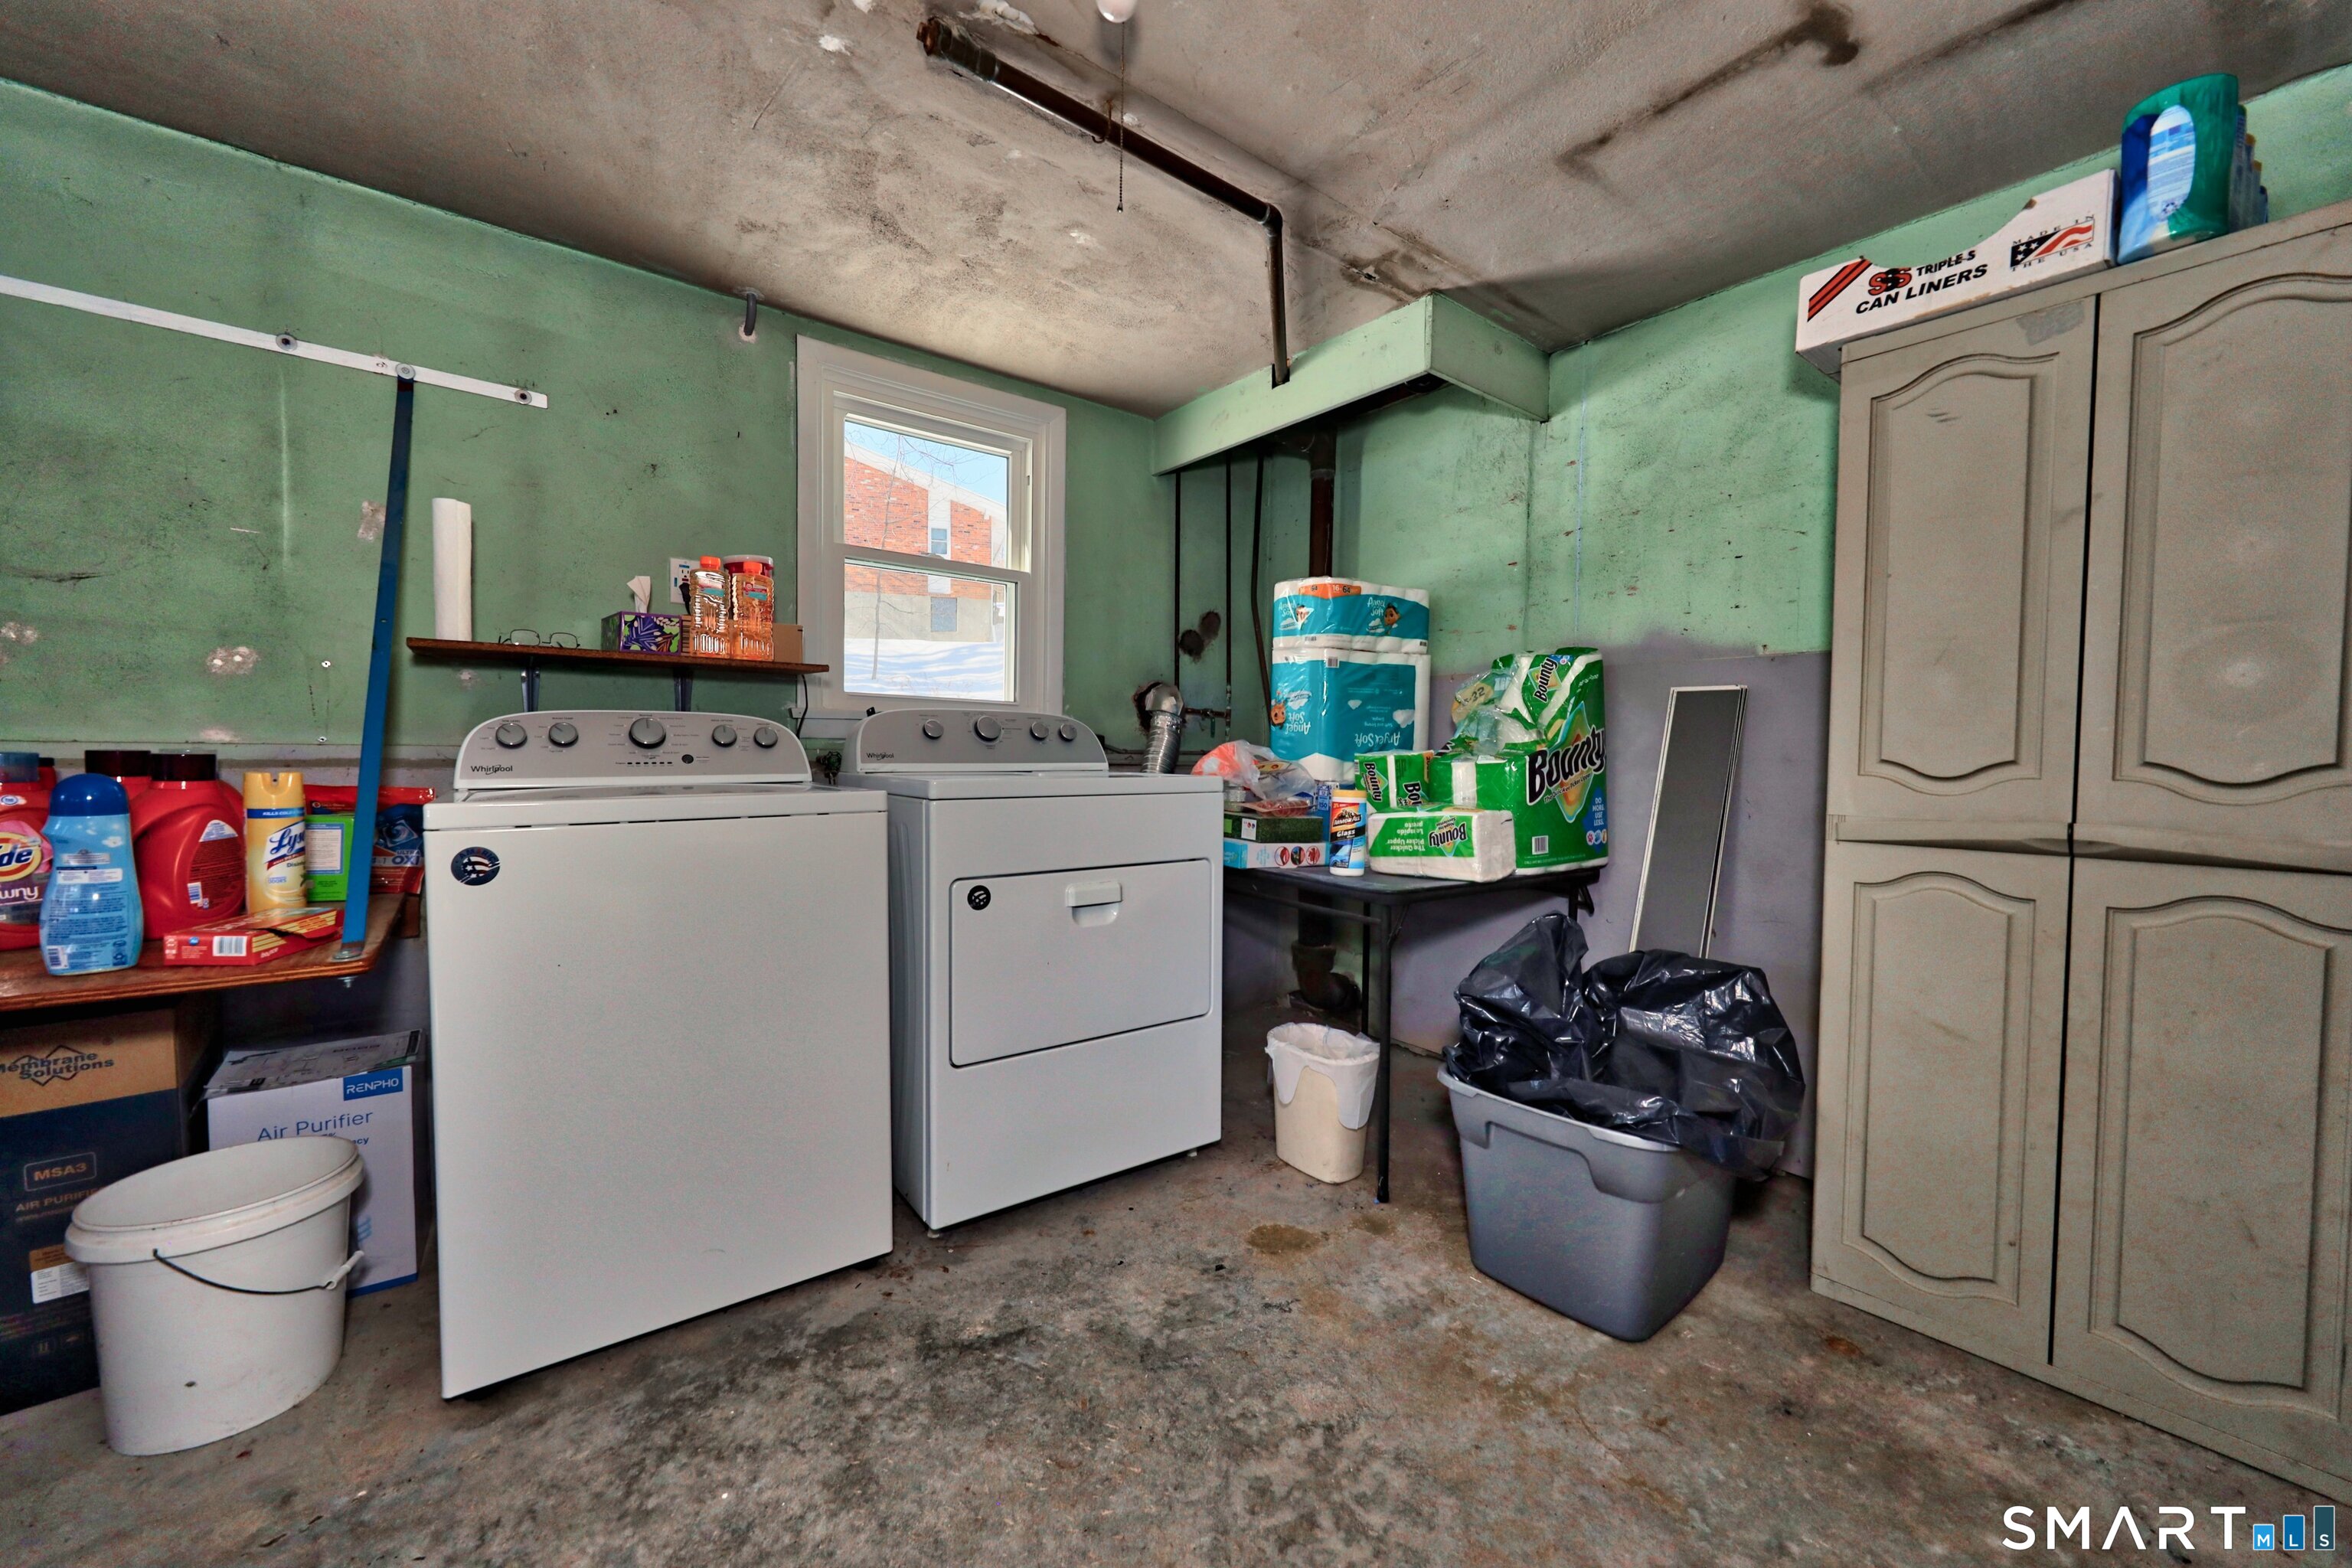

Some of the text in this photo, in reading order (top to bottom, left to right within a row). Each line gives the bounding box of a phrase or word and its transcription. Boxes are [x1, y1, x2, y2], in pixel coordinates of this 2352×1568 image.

[2013, 215, 2094, 245] MADE IN
[2012, 243, 2092, 272] THE USA
[1856, 263, 1988, 315] CAN LINERS
[1534, 657, 1558, 702] Bounty
[1289, 711, 1305, 724] Soft
[1286, 722, 1312, 735] Angel
[1354, 732, 1374, 747] Soft
[866, 752, 894, 761] Whirlpool
[1528, 726, 1606, 804] Bounty
[471, 764, 513, 775] Whirlpool
[1364, 763, 1383, 802] Bounty
[1336, 829, 1356, 838] Glass
[1429, 822, 1468, 848] Bounty
[0, 844, 33, 869] de
[392, 855, 420, 865] OXI
[19, 1059, 114, 1080] Solutions
[346, 1077, 399, 1094] RENPHO
[257, 1112, 374, 1142] Air Purifier
[34, 1161, 87, 1181] MSA3
[15, 1200, 39, 1213] AIR
